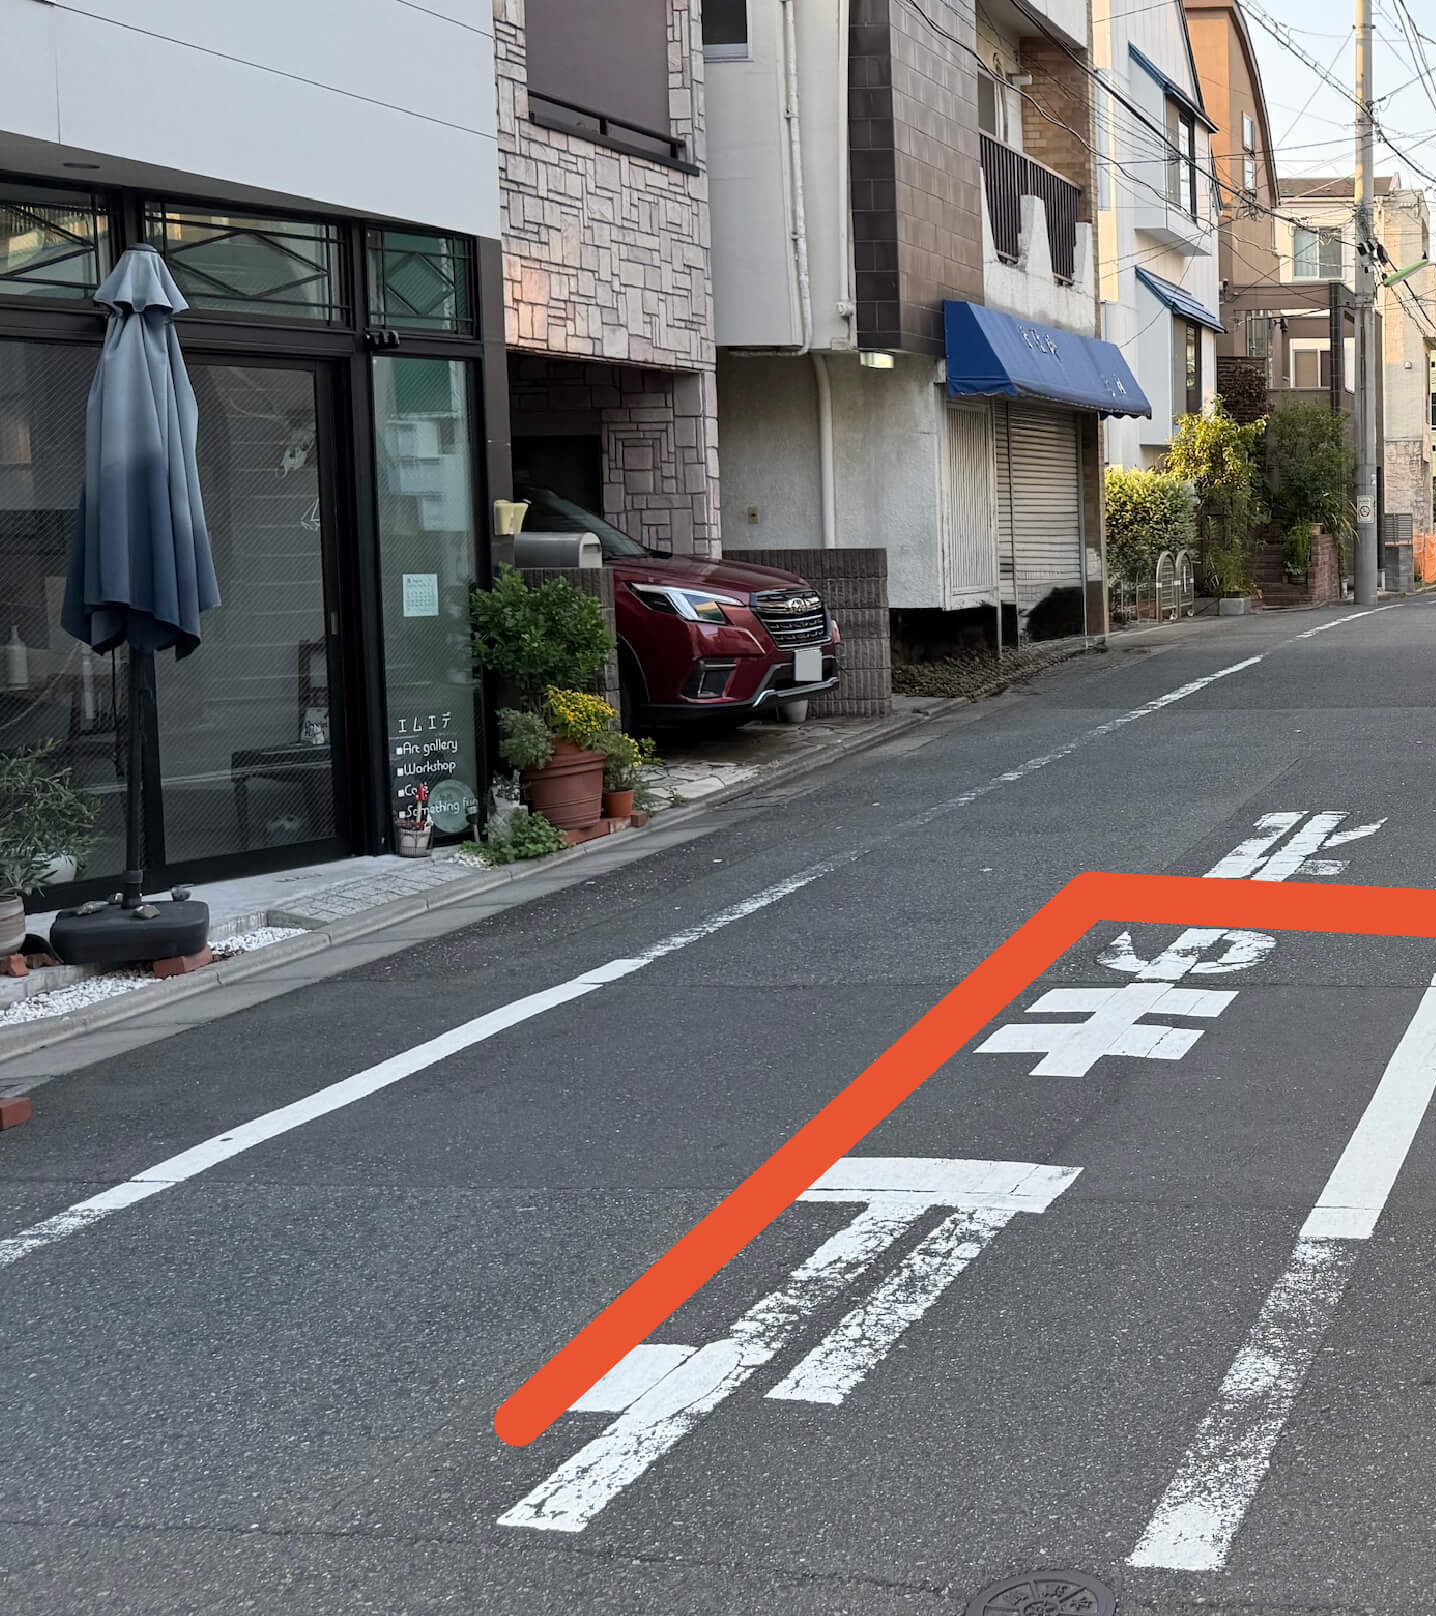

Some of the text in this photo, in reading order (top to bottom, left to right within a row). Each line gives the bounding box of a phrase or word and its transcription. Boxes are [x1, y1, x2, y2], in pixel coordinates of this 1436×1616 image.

[403, 739, 458, 756] Art gallery
[404, 761, 456, 775] Workshop
